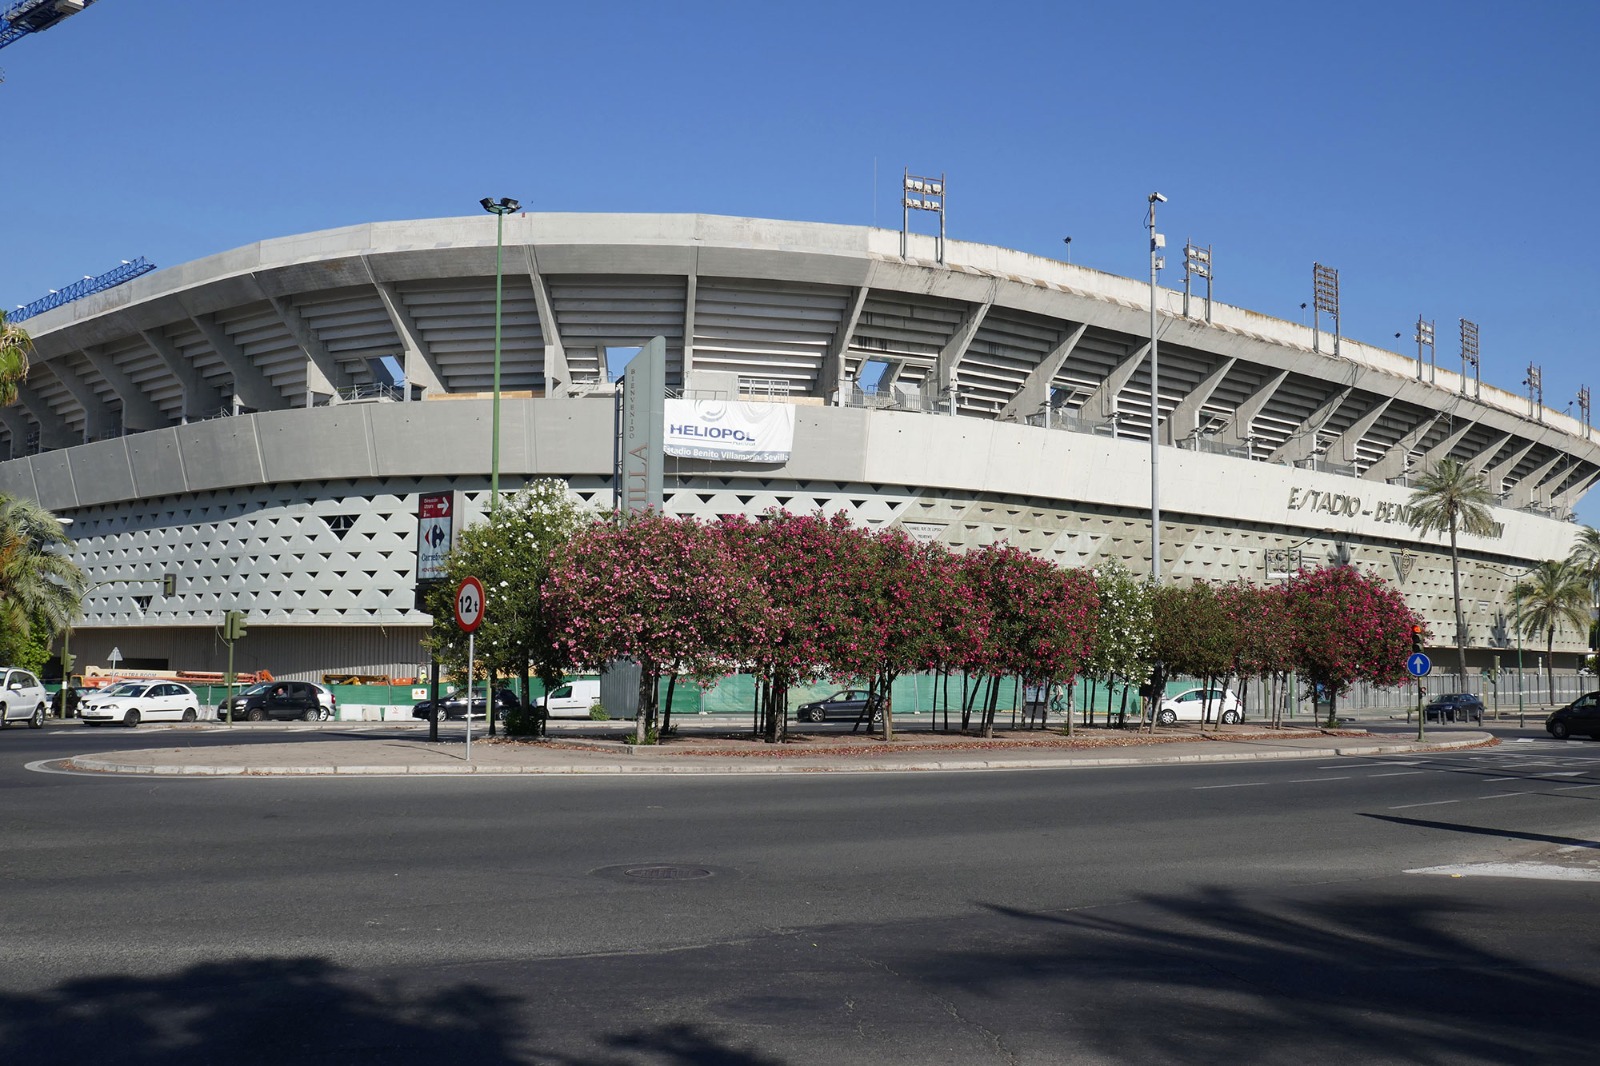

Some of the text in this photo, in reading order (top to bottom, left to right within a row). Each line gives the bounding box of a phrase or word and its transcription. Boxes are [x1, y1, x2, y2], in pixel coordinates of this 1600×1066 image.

[670, 424, 755, 441] HELIOPOL
[693, 448, 719, 459] Benito
[764, 453, 790, 462] Sevilla
[1287, 486, 1361, 518] ESTADIO
[460, 595, 479, 613] 12 t
